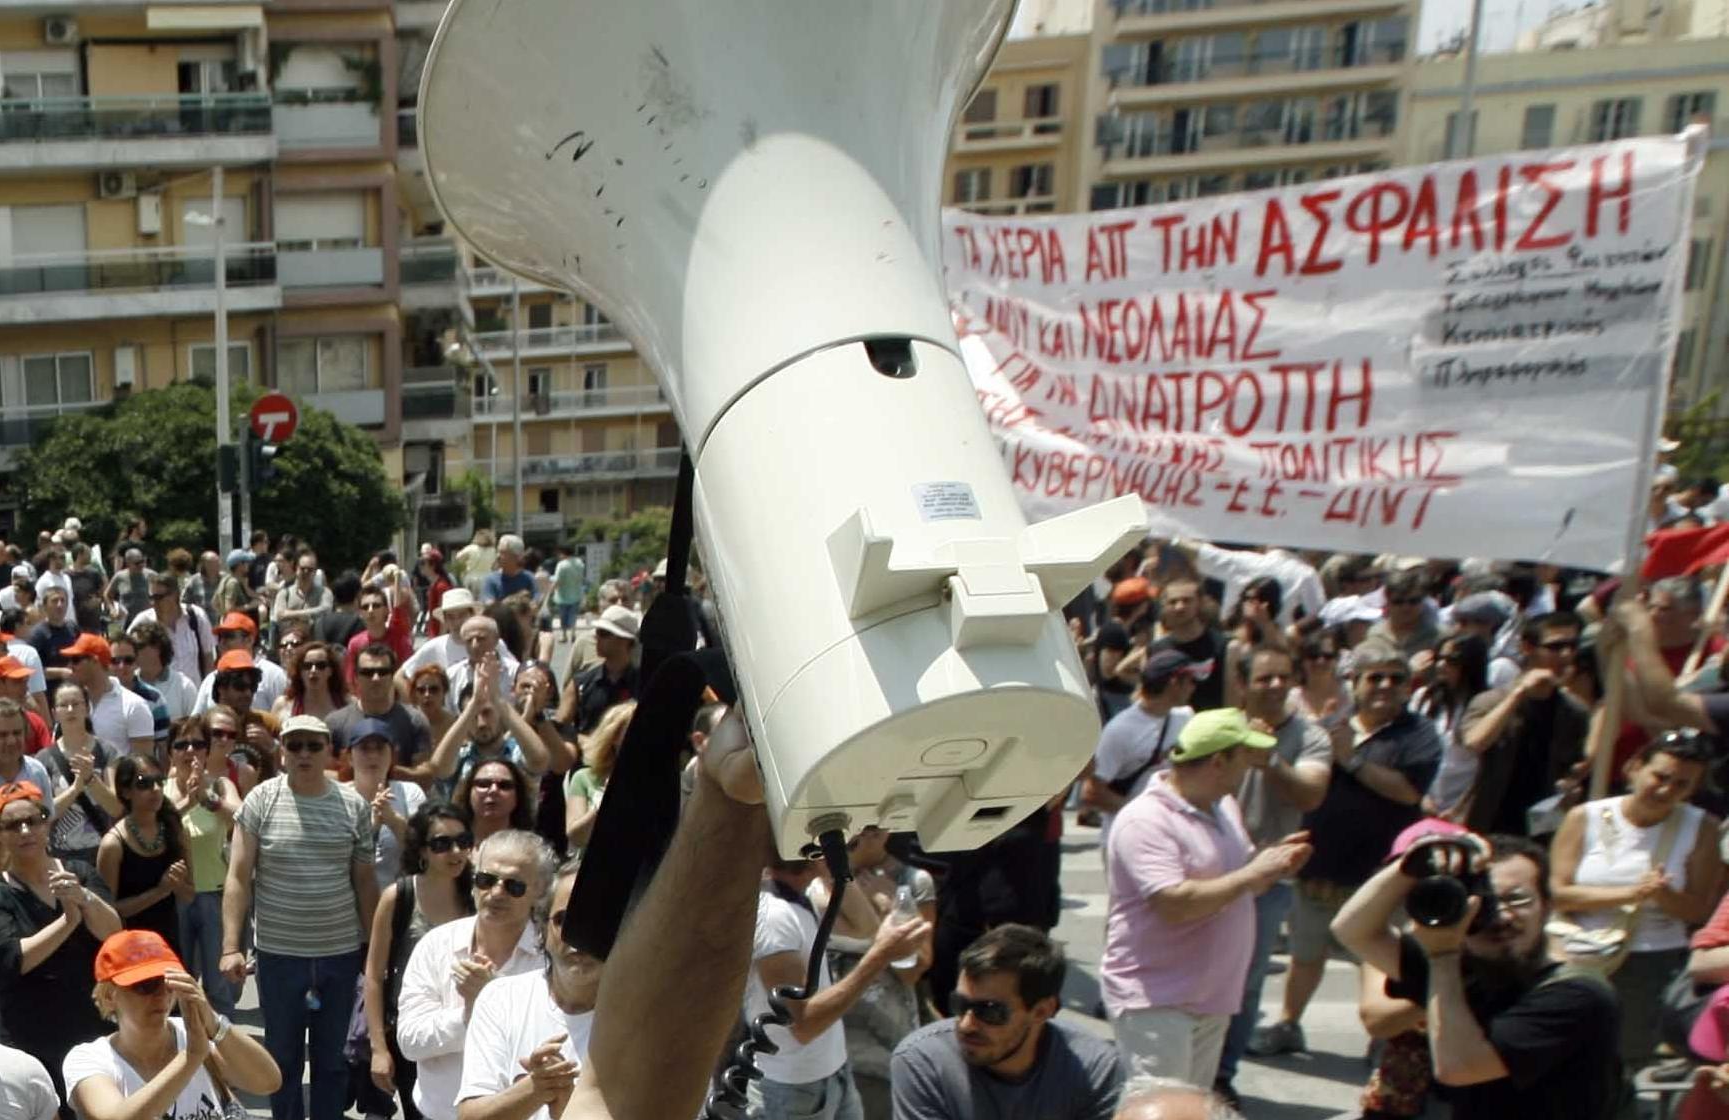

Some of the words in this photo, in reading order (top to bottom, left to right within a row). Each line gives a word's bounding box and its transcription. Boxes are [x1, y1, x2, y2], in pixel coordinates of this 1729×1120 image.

[1152, 210, 1240, 274] ΤΗΝ
[1254, 151, 1632, 276] ΑΣΦΑΛΙΣΗ
[1089, 357, 1372, 435] ΑΝΑΤΡΟΠΗ
[1249, 431, 1462, 484] ΠΟΛΙΤΙΚΗΣ
